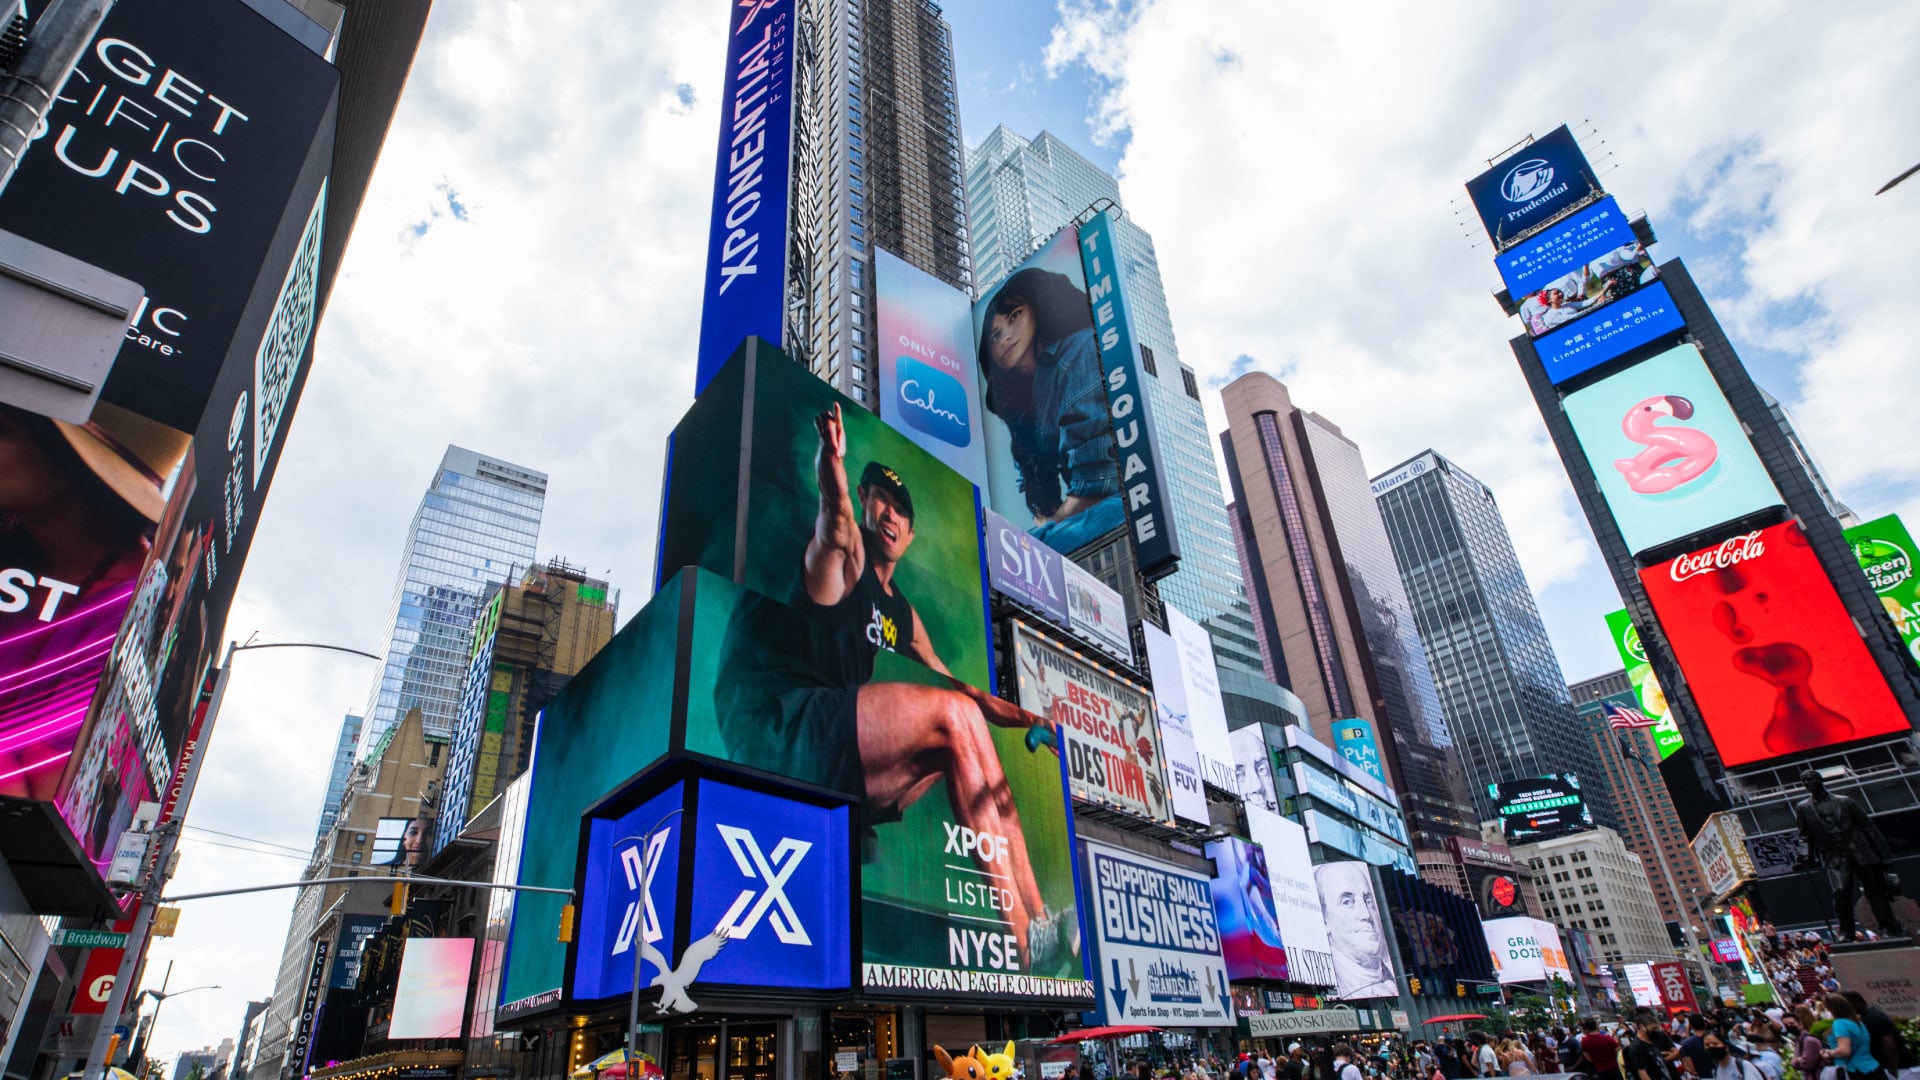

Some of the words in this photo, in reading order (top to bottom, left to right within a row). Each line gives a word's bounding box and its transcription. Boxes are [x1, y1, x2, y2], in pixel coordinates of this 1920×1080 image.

[769, 12, 786, 104] FITNESS
[96, 37, 249, 136] GET
[29, 121, 217, 234] UPS
[720, 23, 771, 296] XPONENTIAL
[1507, 182, 1569, 221] Prudential
[1517, 265, 1543, 280] Where
[1547, 254, 1563, 264] the
[1566, 227, 1615, 254] Elephants
[1527, 241, 1572, 267] Greetings
[1577, 227, 1598, 240] from
[1634, 308, 1665, 324] China
[899, 335, 938, 360] ONLY
[940, 354, 961, 372] ON
[900, 379, 967, 427] Calm
[1084, 230, 1120, 351] TIMES
[1109, 365, 1157, 544] SQUARE
[1371, 471, 1409, 493] Allianz
[1000, 528, 1060, 601] SIX
[1670, 530, 1765, 583] Coca-Cola
[1863, 557, 1906, 577] reen
[1870, 567, 1913, 588] iant
[1027, 641, 1088, 684] WINNER!
[1088, 676, 1095, 689] 8
[1095, 677, 1112, 696] TONY
[1113, 684, 1140, 711] AWARDS
[1066, 681, 1111, 720] BEST
[1052, 698, 1132, 753] MUSICAL
[1174, 770, 1197, 794] FUV
[942, 821, 1010, 866] XPOF
[1720, 815, 1744, 855] MISSED
[1099, 858, 1166, 900] SUPPORT
[1165, 878, 1212, 910] SMALL
[1736, 855, 1757, 876] WE
[945, 878, 1014, 913] LISTED
[67, 932, 124, 948] Broadway
[1101, 889, 1219, 953] BUSINESS
[948, 927, 1020, 972] NYSE
[98, 980, 114, 997] P
[866, 964, 963, 993] AMERICAN
[967, 970, 1015, 994] EAGLE
[1017, 976, 1095, 998] OUTFITTERS
[1659, 966, 1684, 1002] tkts
[294, 945, 326, 1068] SCIENTOLOGY
[1130, 1006, 1147, 1017] Sports
[1147, 1008, 1157, 1016] Fan
[1158, 1008, 1169, 1018] Shop
[1173, 1008, 1182, 1017] NYC
[1183, 1008, 1199, 1018] Apparel
[1250, 1014, 1326, 1032] SWAROVSKI
